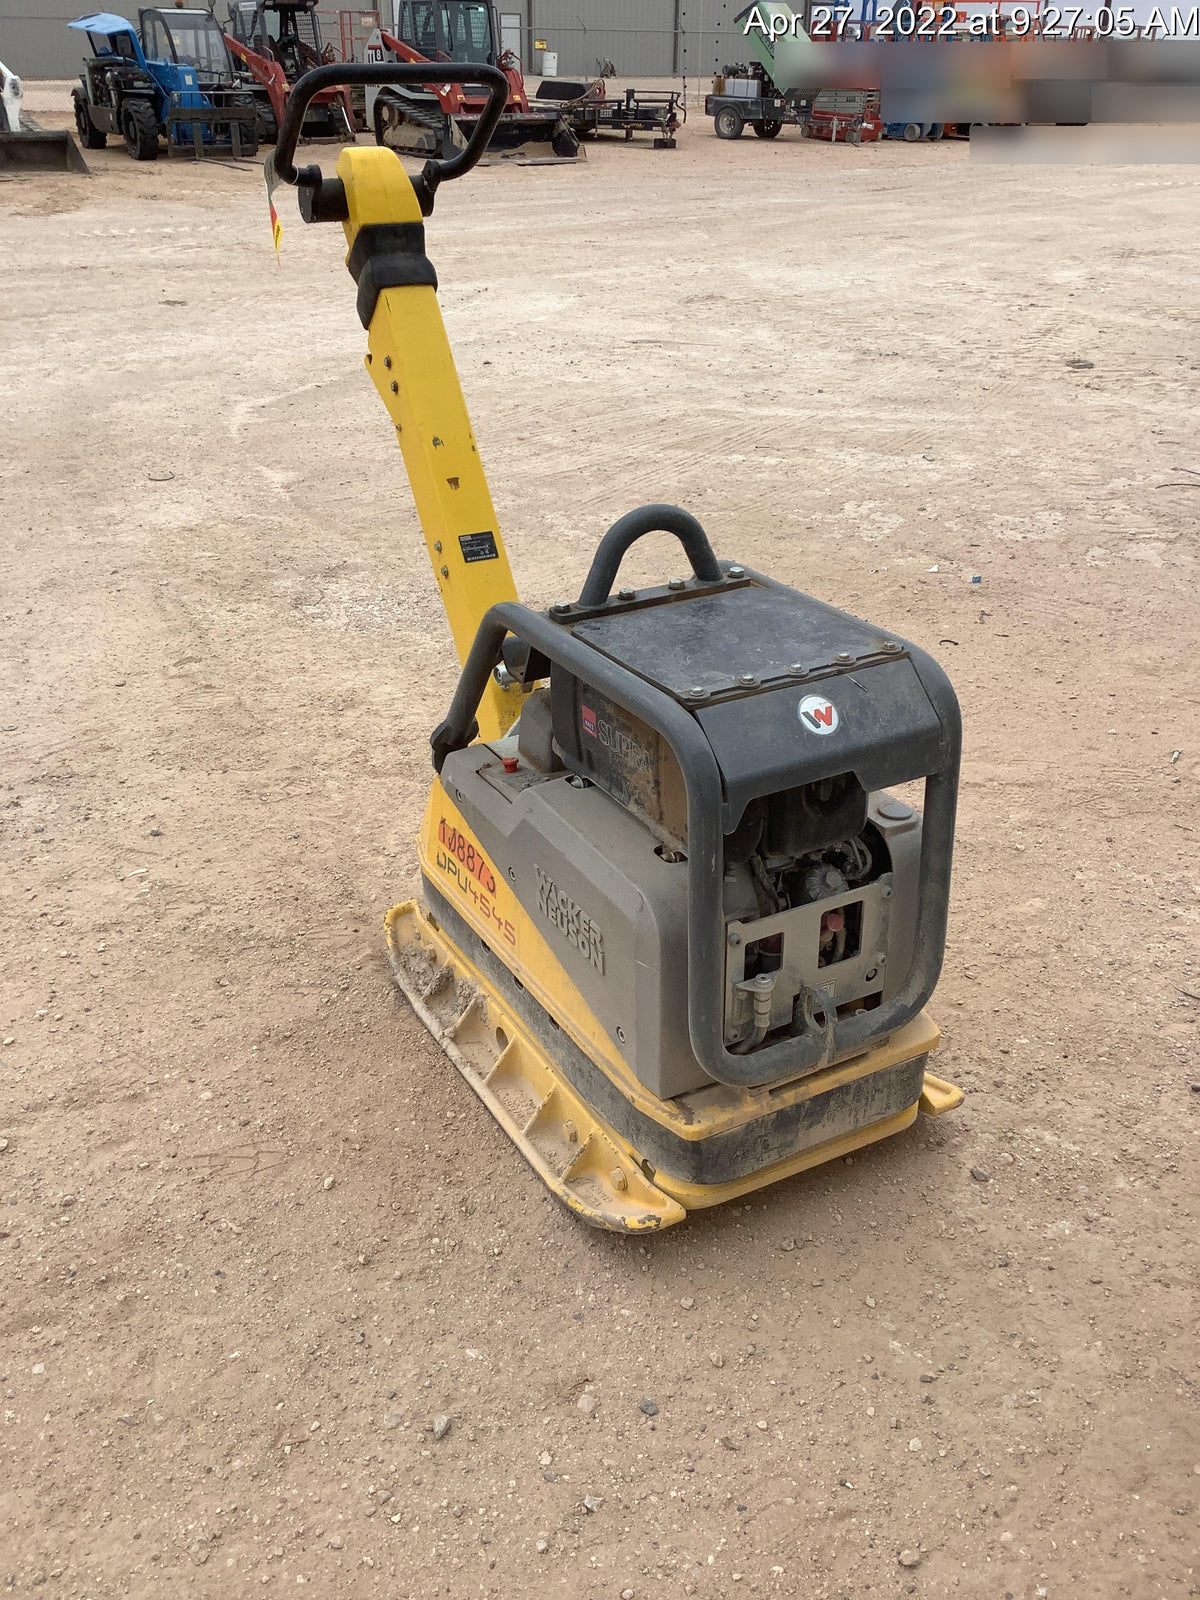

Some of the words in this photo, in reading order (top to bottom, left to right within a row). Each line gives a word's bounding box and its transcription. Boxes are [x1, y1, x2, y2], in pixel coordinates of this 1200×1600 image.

[437, 851, 516, 946] DPU4545
[534, 863, 605, 956] WACKER
[536, 886, 606, 977] NEUSON
